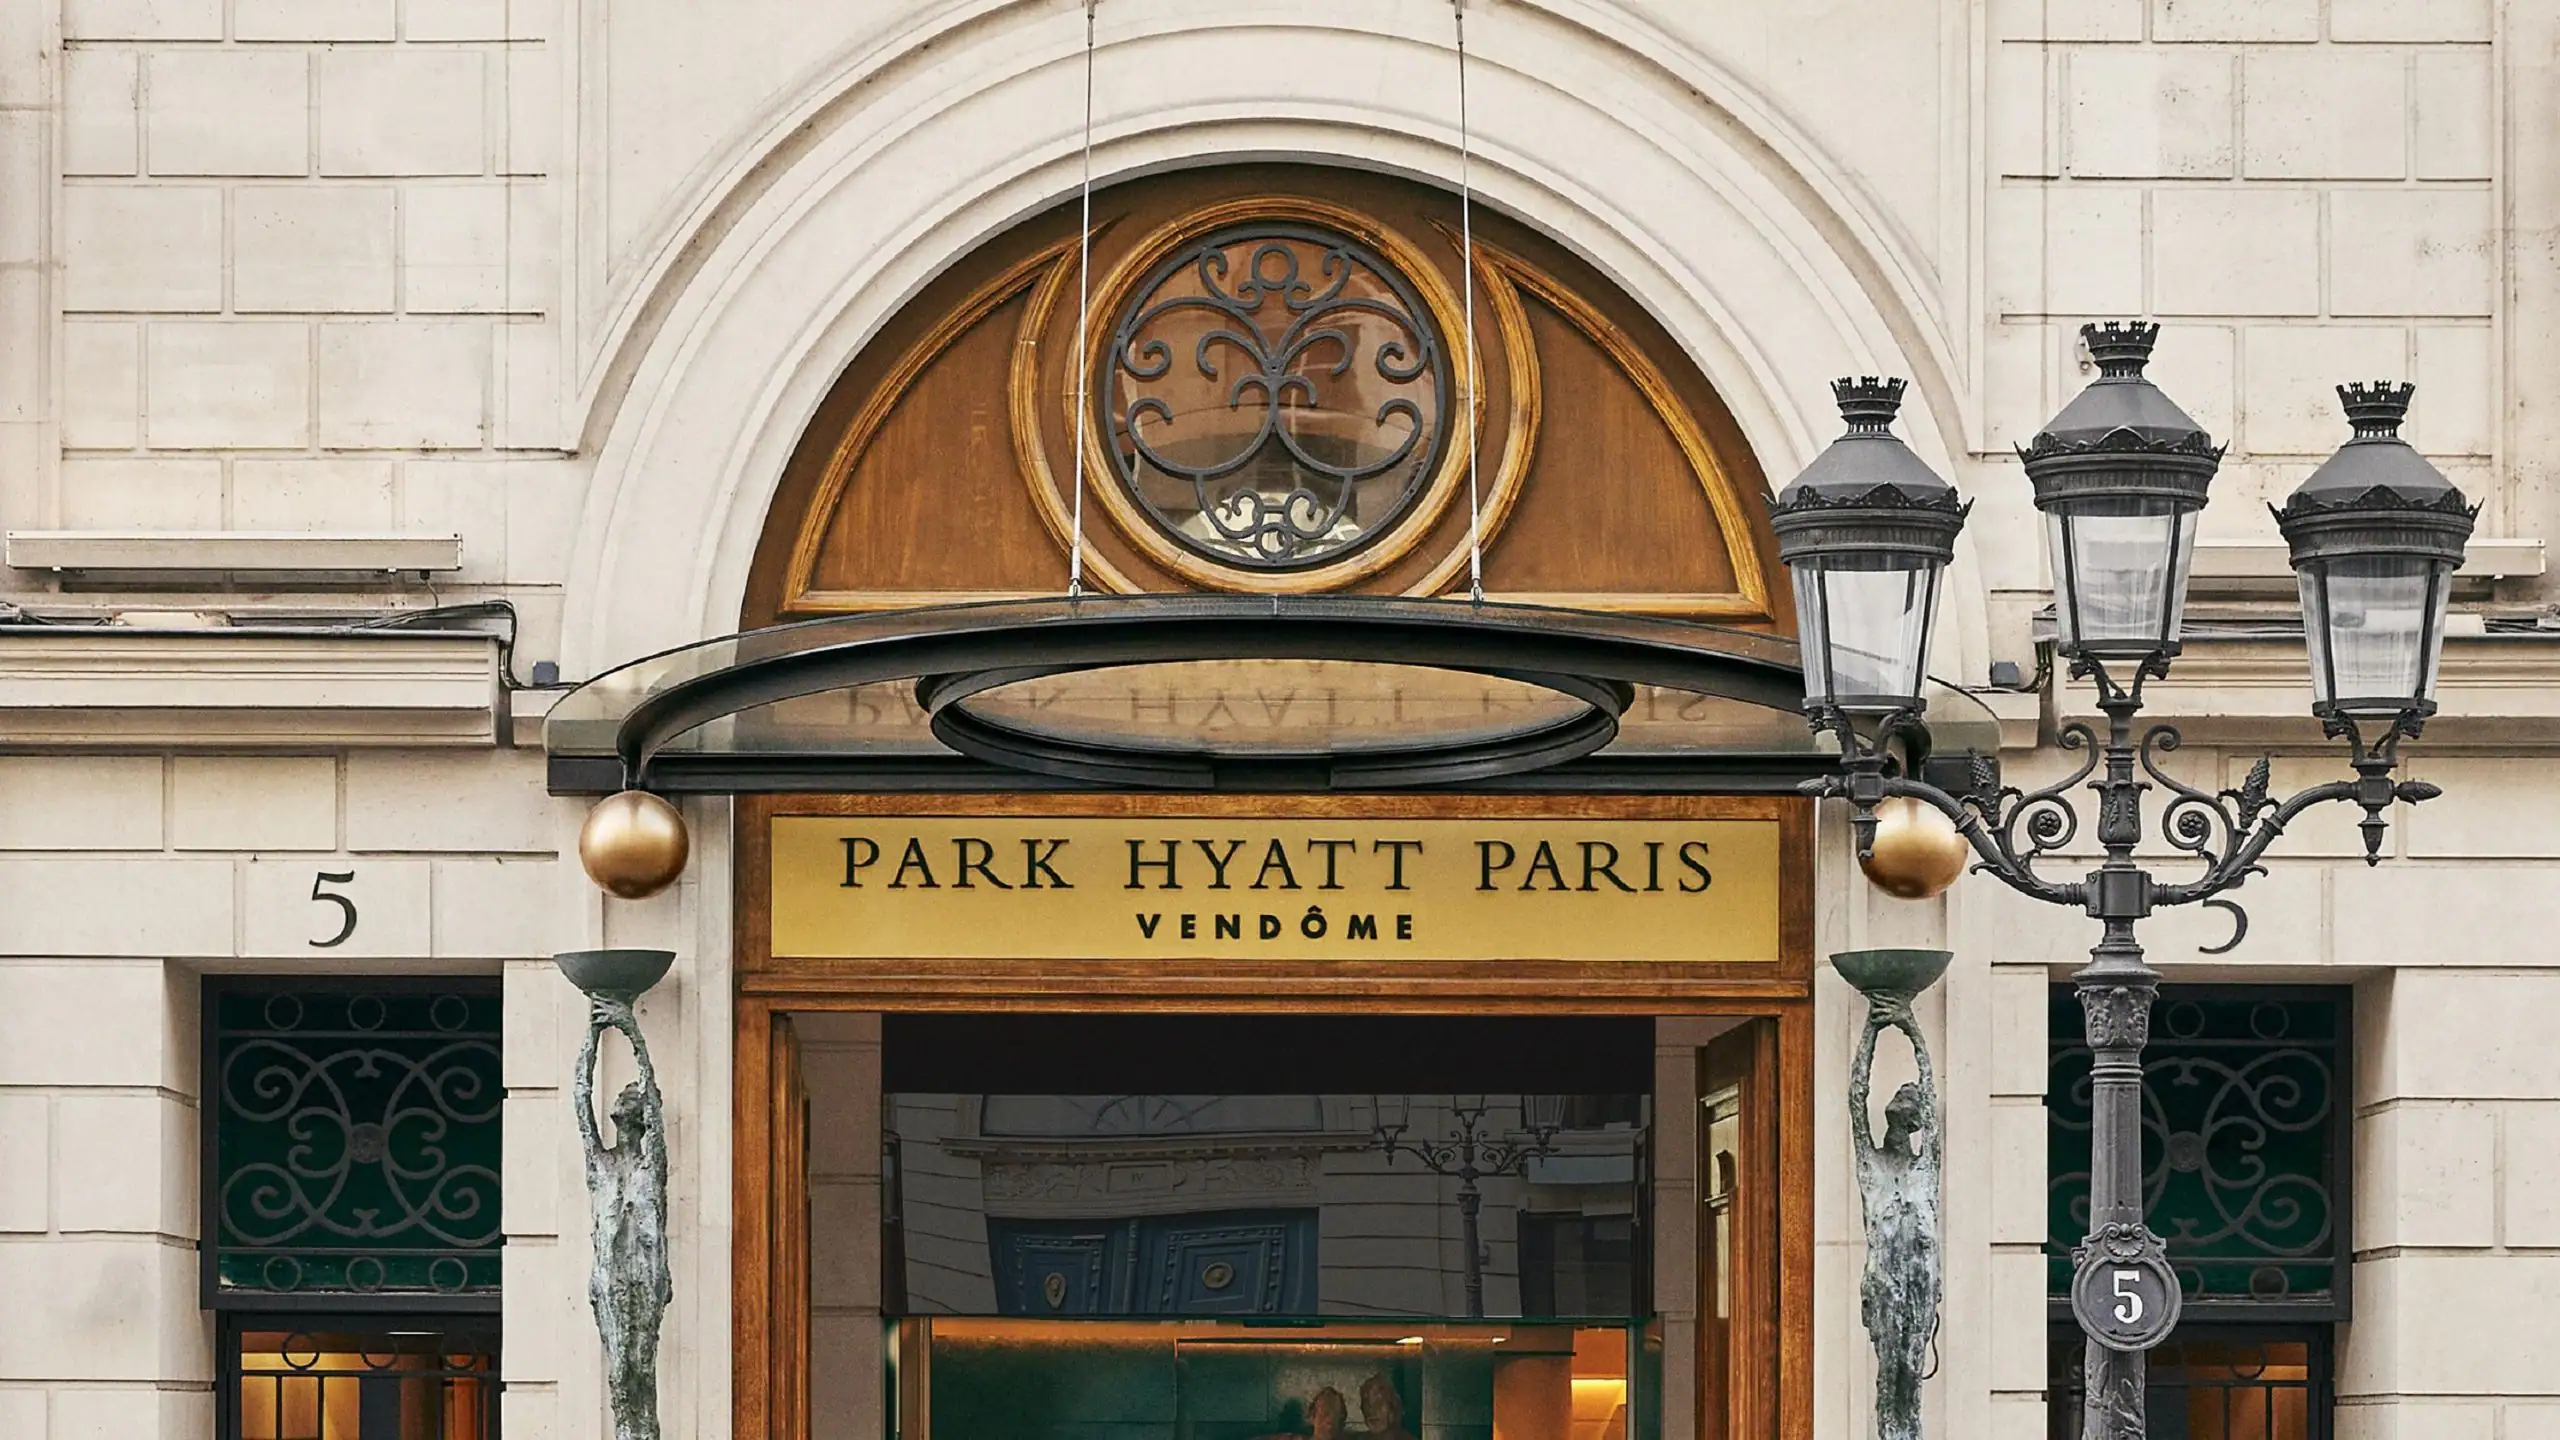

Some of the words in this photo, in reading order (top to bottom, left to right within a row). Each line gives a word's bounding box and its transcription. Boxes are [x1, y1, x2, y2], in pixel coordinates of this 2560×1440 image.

[838, 837, 1075, 890] PARK
[1123, 838, 1424, 891] HYATT
[1473, 840, 1712, 894] PARIS
[308, 870, 357, 947] 5
[1135, 904, 1413, 941] VENDÔME
[2112, 1270, 2143, 1325] 5
